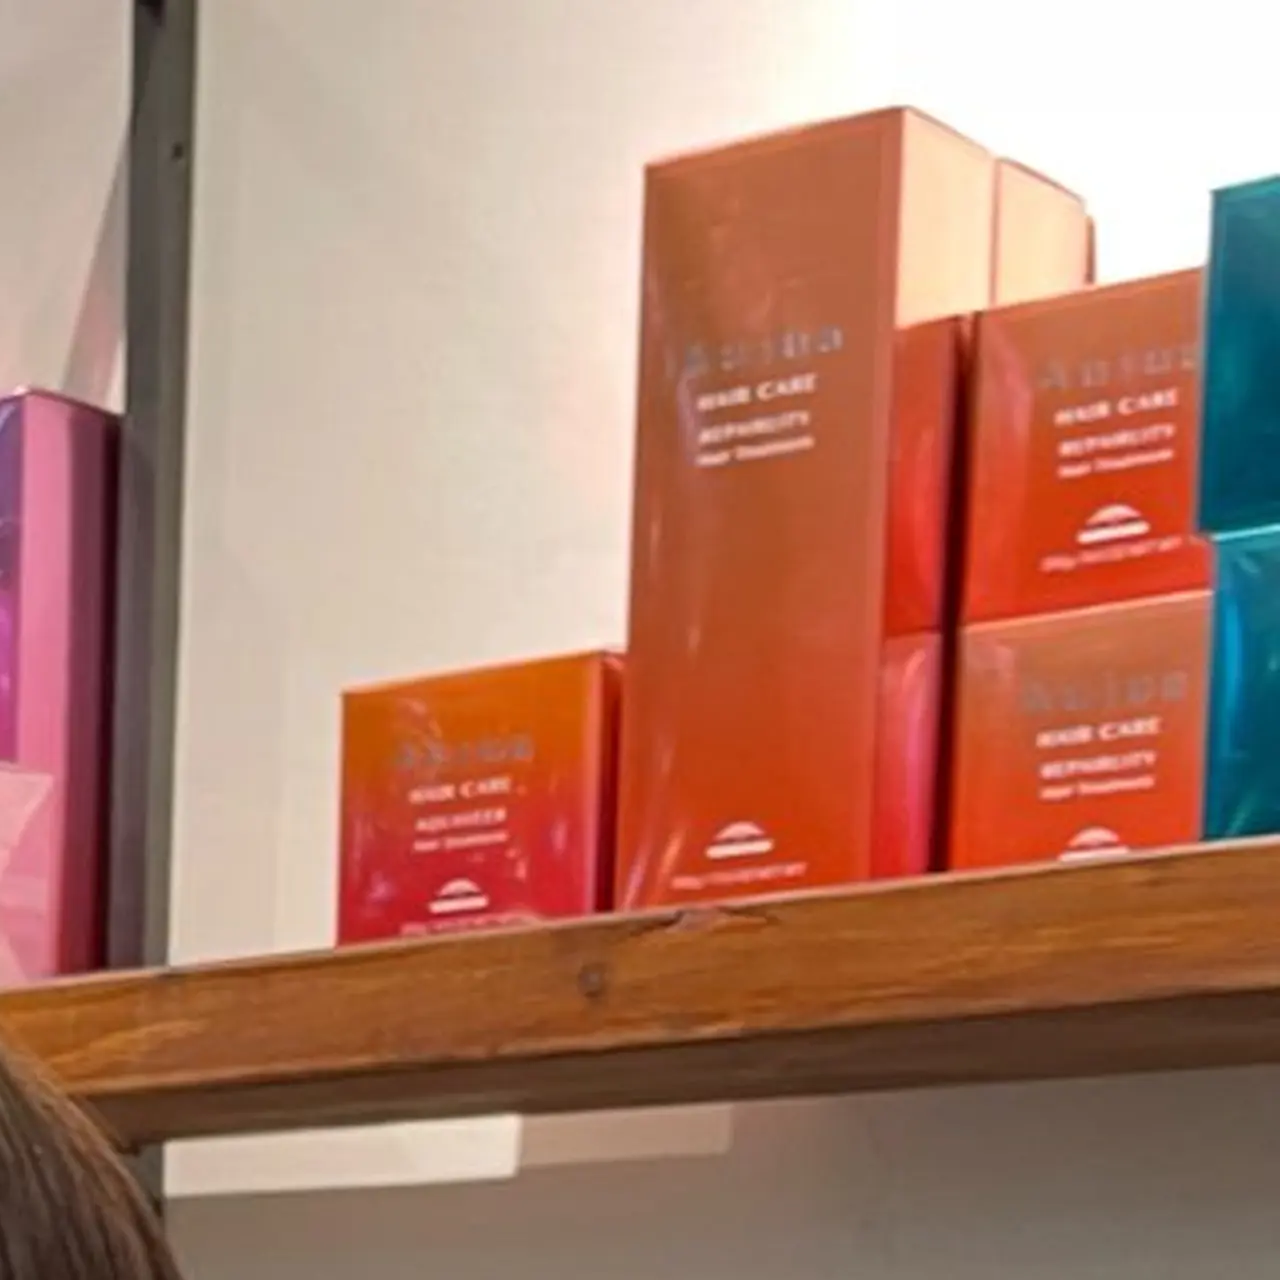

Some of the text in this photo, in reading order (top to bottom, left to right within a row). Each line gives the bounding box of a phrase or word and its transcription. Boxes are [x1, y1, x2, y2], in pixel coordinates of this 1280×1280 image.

[756, 372, 817, 401] CARE
[1117, 388, 1178, 416] CARE
[1098, 716, 1161, 742] CARE
